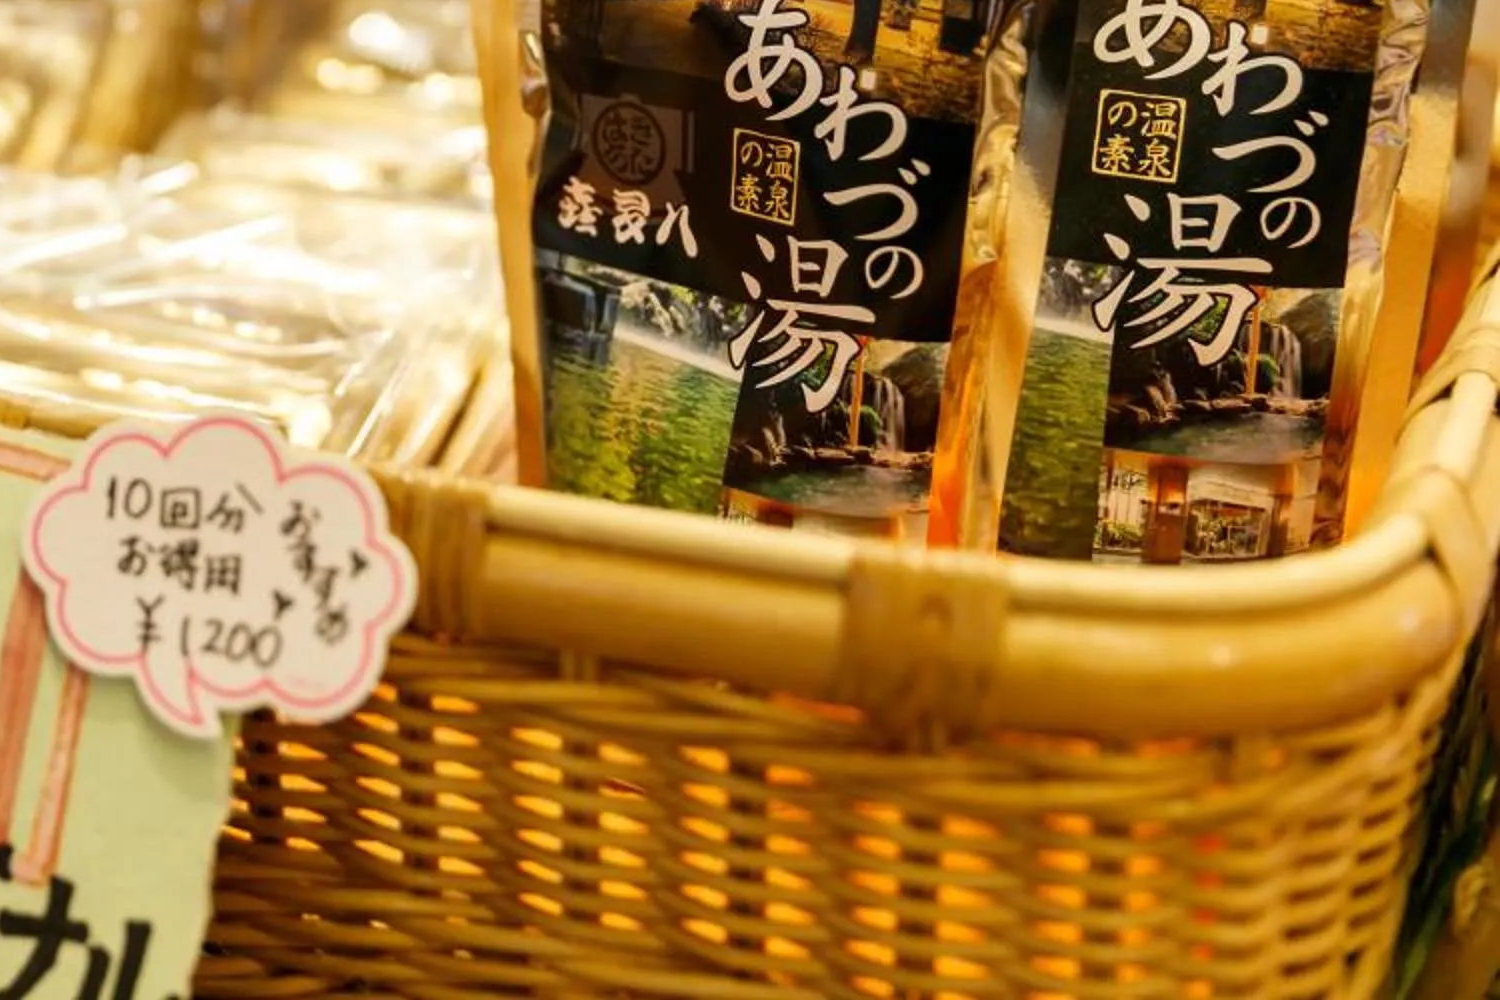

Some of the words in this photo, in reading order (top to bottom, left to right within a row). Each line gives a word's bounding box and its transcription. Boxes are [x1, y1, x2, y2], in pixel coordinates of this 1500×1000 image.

[1099, 101, 1138, 173] の素
[1138, 101, 1178, 177] 温泉
[736, 140, 764, 212] の素
[764, 142, 794, 220] 温泉
